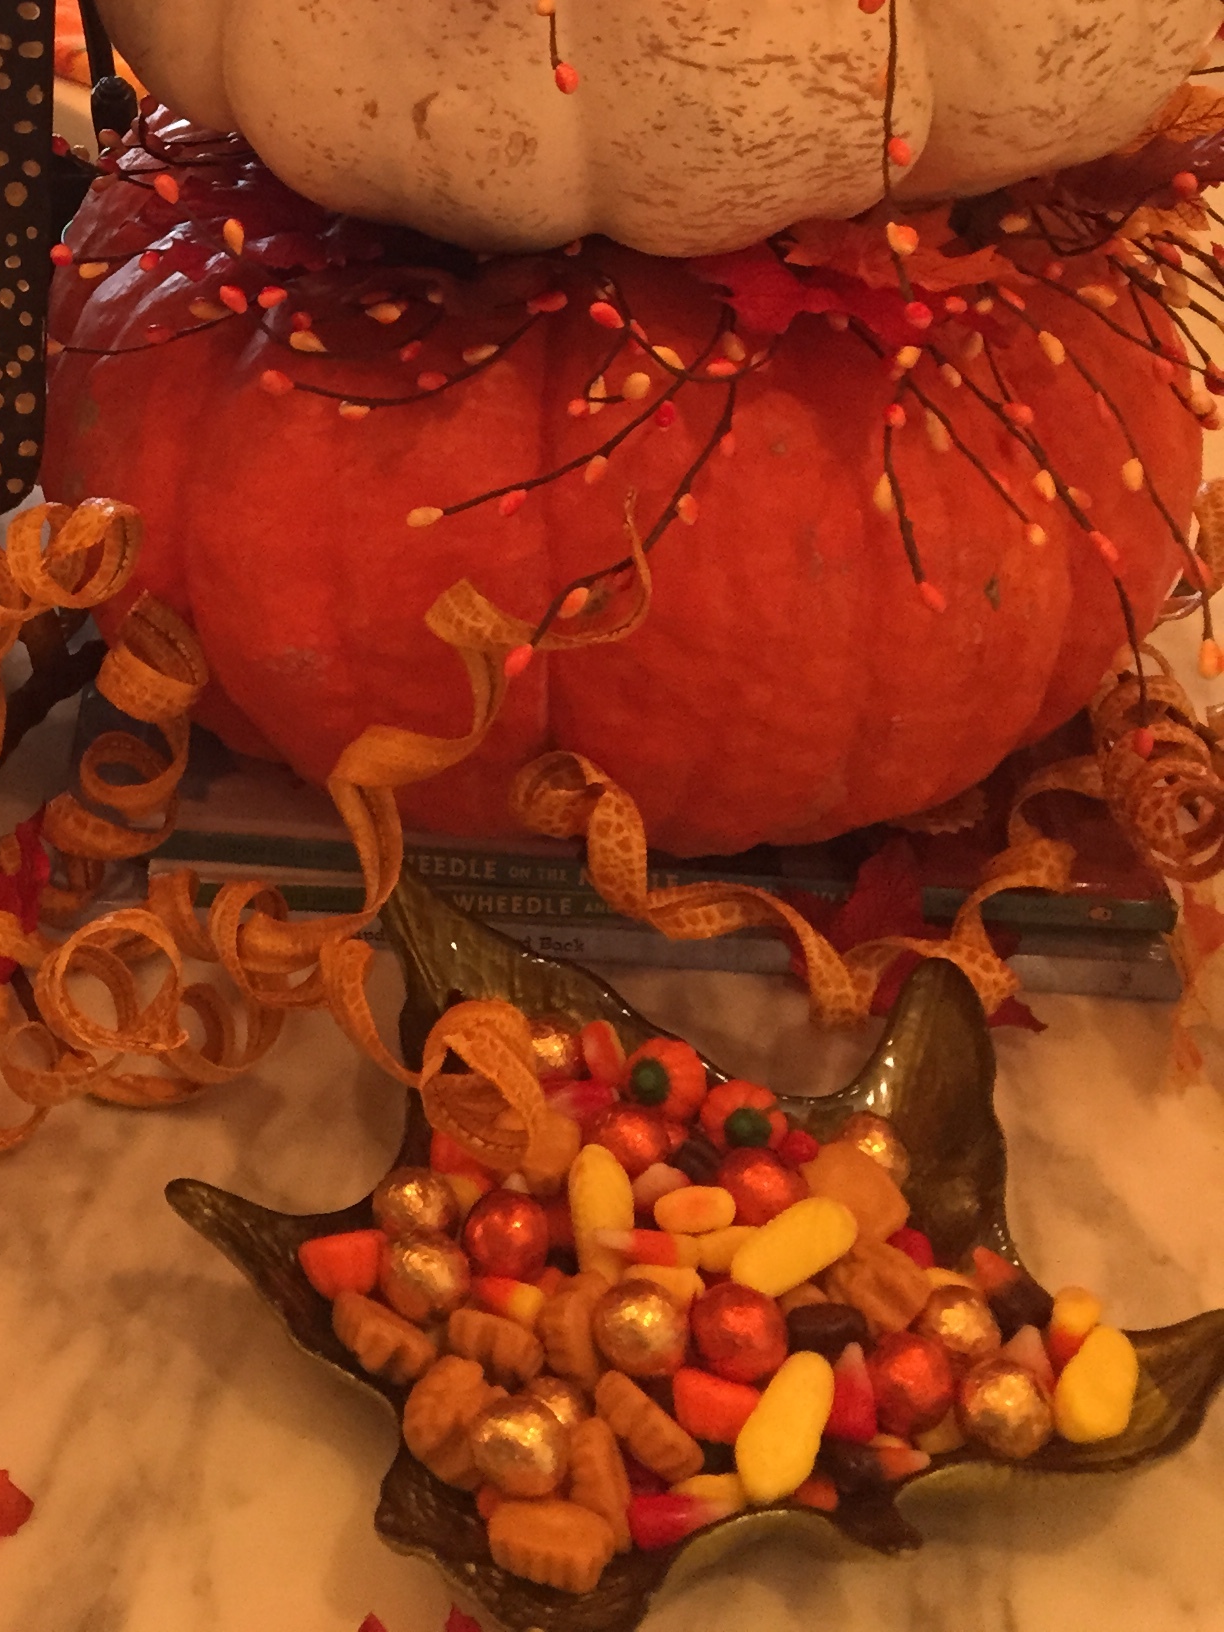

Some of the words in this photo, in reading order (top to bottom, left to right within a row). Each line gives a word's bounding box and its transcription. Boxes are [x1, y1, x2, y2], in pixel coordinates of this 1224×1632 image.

[403, 855, 497, 880] EEDLE
[508, 866, 529, 879] ON
[536, 868, 567, 882] THE
[452, 893, 572, 916] WHEEDLE
[539, 936, 585, 953] Back
